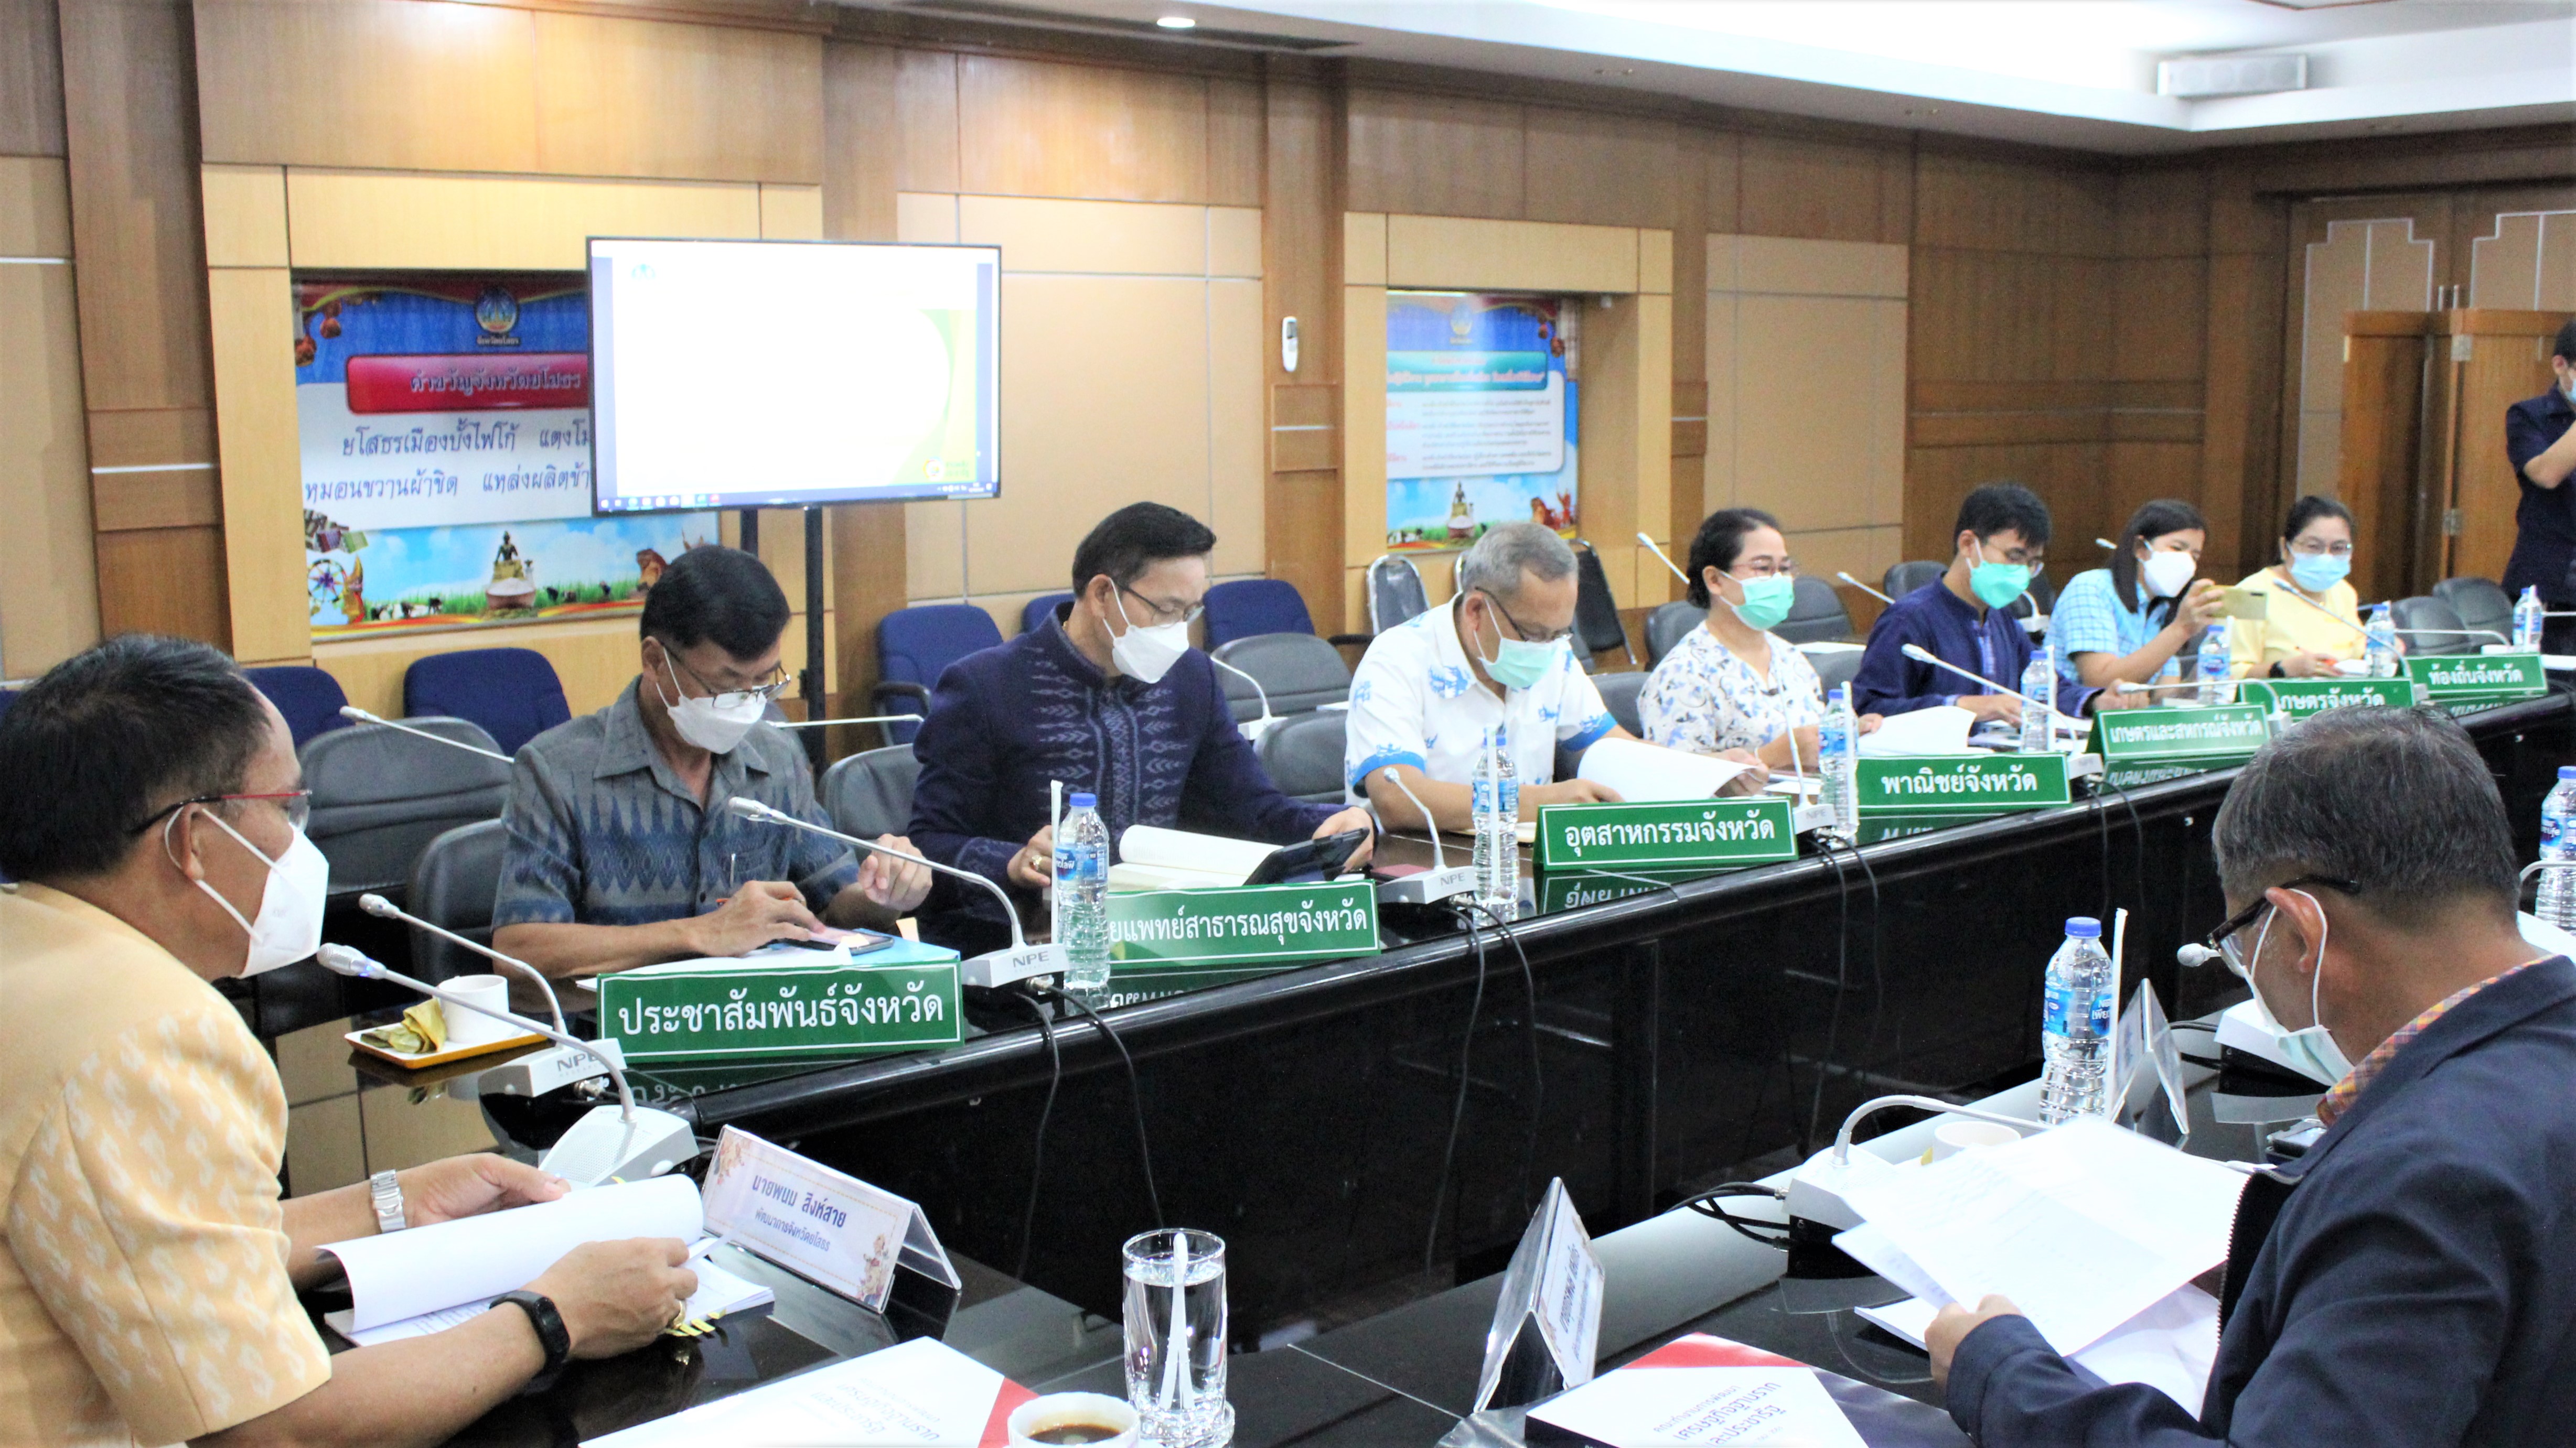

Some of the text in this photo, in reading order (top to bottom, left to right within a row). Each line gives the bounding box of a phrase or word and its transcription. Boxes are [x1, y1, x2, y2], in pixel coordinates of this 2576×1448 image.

[410, 364, 581, 397] คำขวัญจังหวัดยโสธร
[342, 418, 519, 457] ยโสธรเมืองบั้งไฟโก้
[305, 461, 590, 502] หมอนขวานผ้าขิด แหล่งผลิตข้า
[2428, 659, 2524, 686] ท้องถิ่นจังหวัด
[2279, 686, 2386, 710] กษตรจังหวัด
[2109, 712, 2264, 743] เกษตรและสหกรณ์จังหวัด
[1881, 763, 2038, 795] พาณิชย์จังหวัด
[1564, 809, 1776, 857] อุตสาหกรรมจังหวัด
[1440, 872, 1465, 886] NPE
[1109, 897, 1367, 946] ยแพทย์สาธารณสุขจังหวัด
[1013, 951, 1049, 968] NPE
[618, 980, 944, 1035] ประชาสัมพันธ์จังหวัด
[752, 1174, 847, 1228] นายพนม สิงห์สาย
[755, 1206, 831, 1252] พัฒนาการจังหวัดยโสธร
[1672, 1382, 1782, 1441] เศรษฐกิจฐานราก
